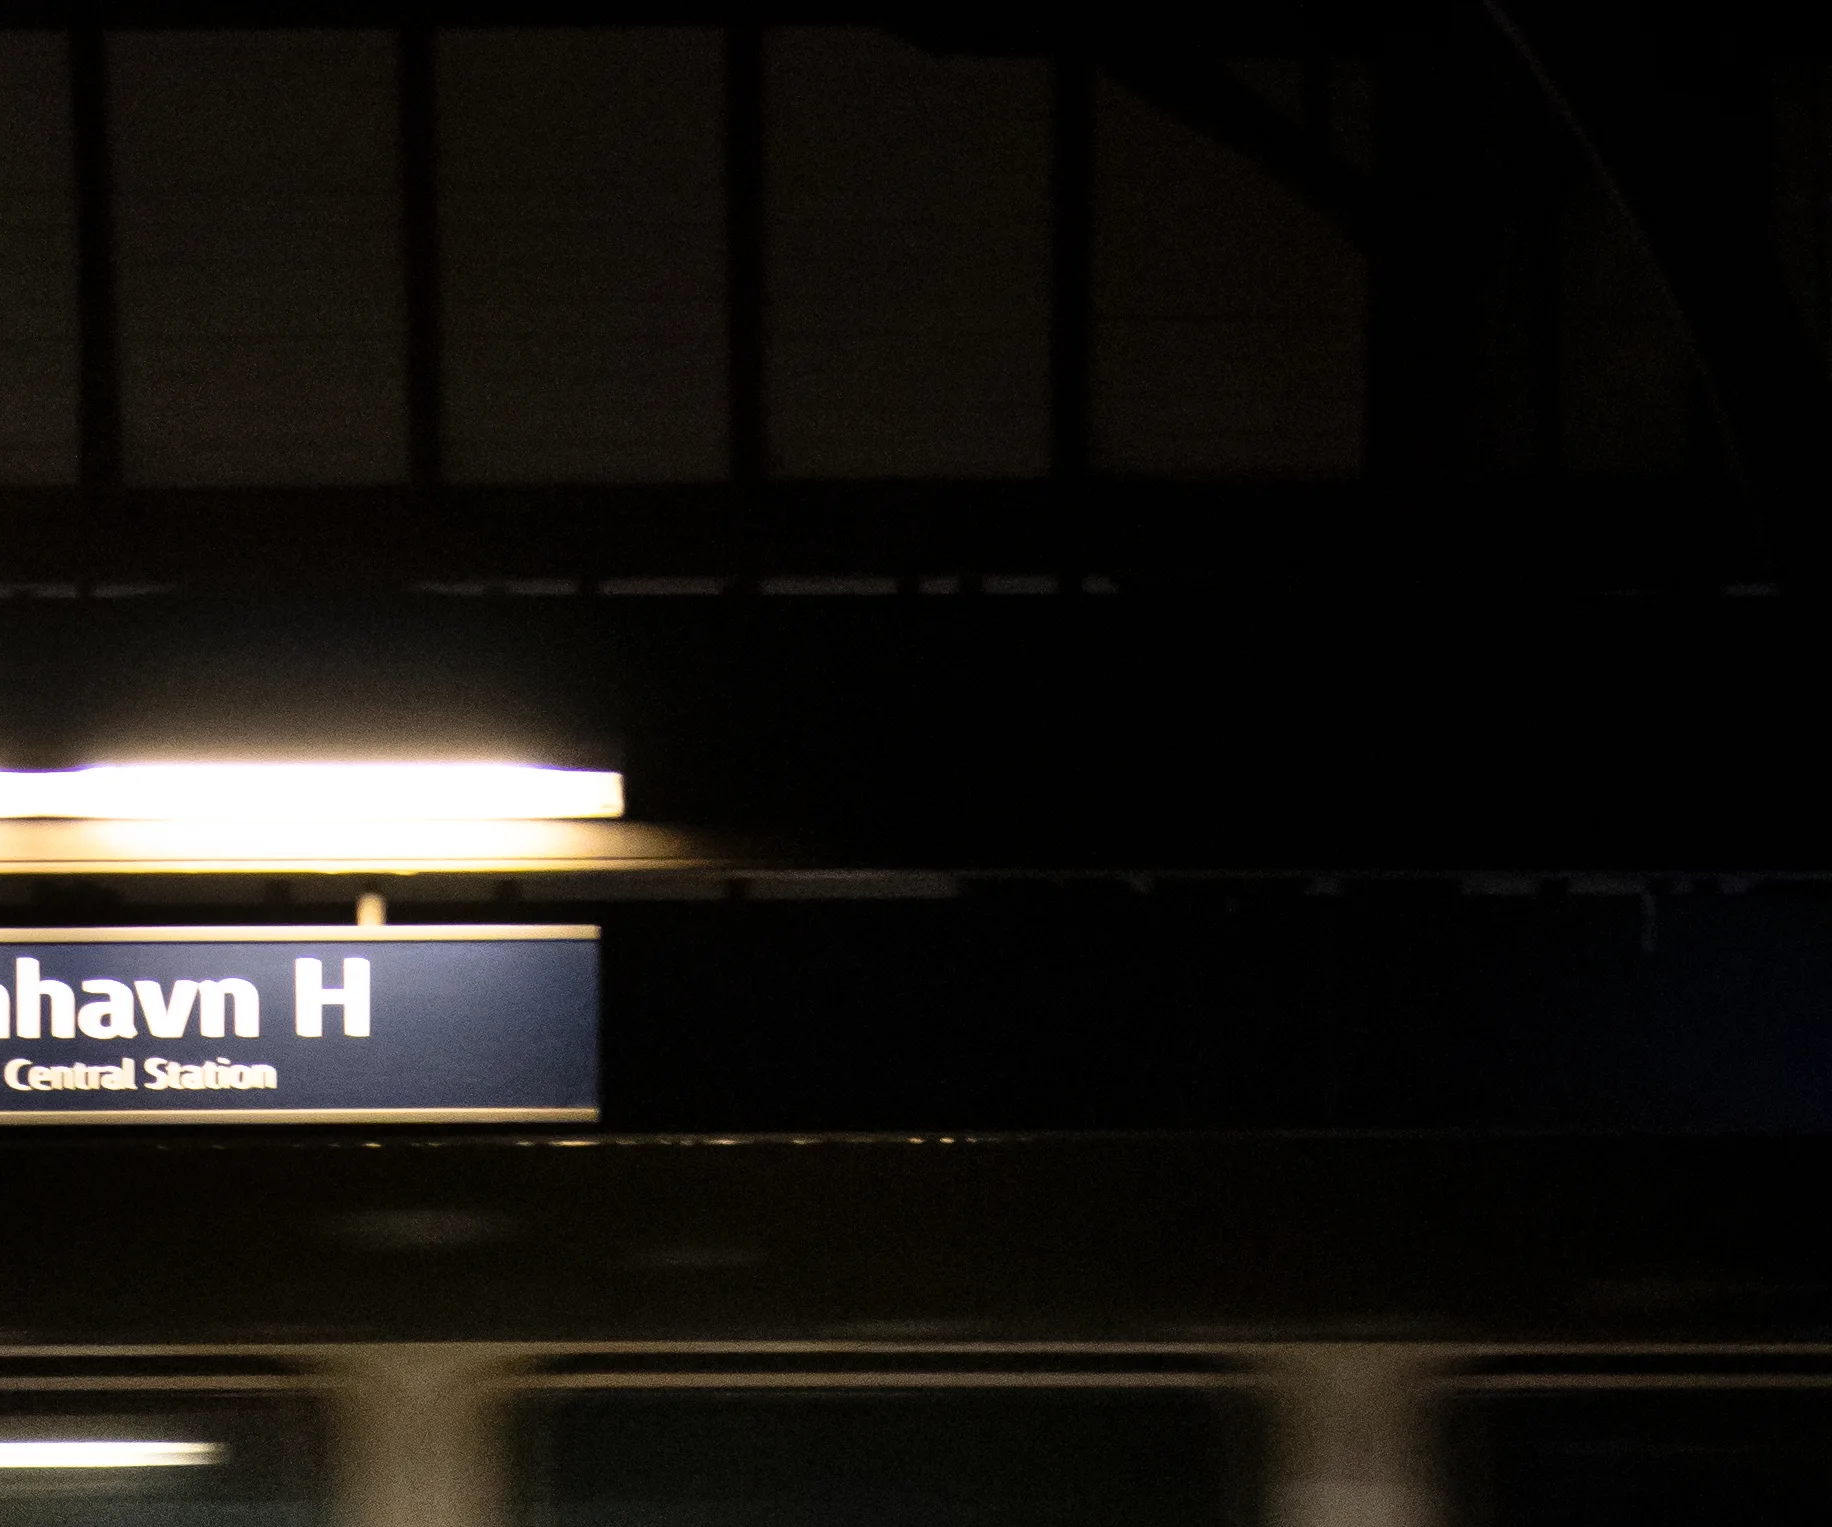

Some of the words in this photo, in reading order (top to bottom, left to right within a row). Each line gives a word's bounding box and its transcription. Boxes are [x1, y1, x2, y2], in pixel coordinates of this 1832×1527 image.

[294, 955, 373, 1038] H
[3, 1057, 138, 1091] Central
[143, 1056, 278, 1091] Station
